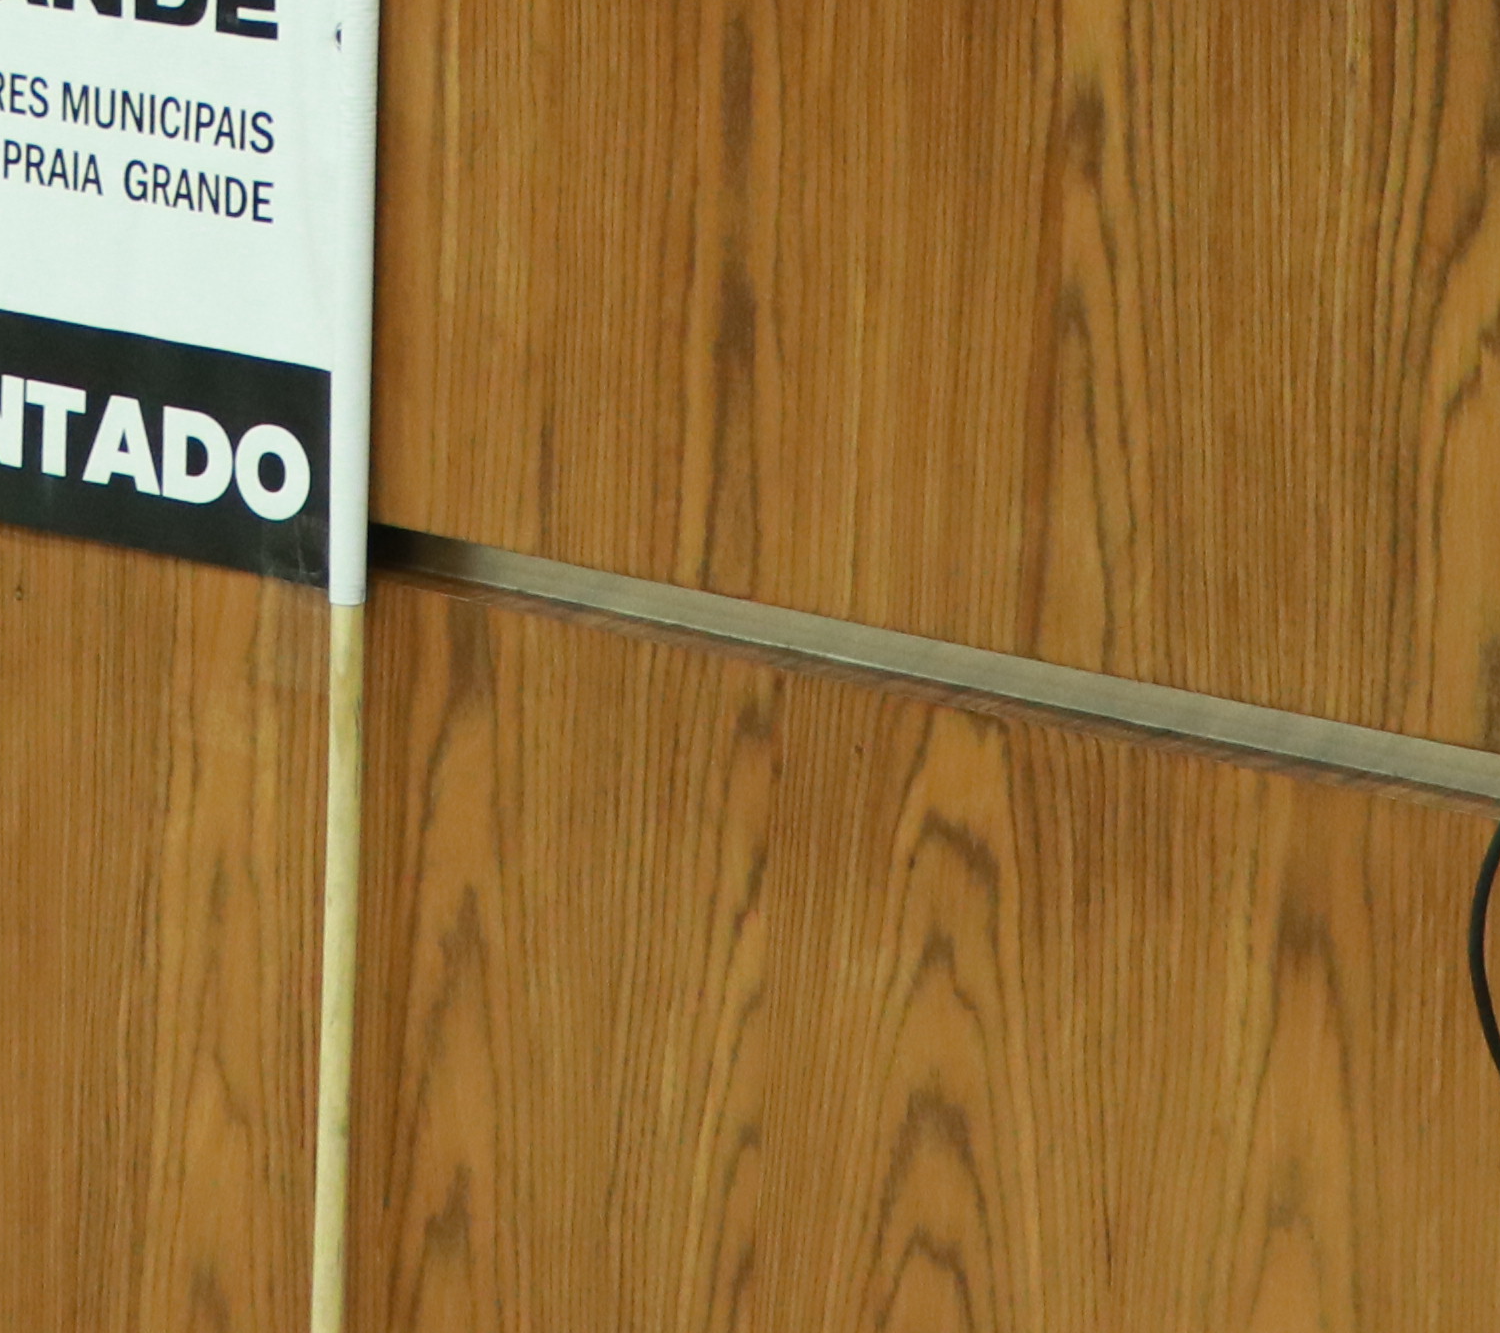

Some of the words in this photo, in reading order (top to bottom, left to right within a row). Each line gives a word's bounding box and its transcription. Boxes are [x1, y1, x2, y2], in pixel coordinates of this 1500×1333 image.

[61, 81, 275, 154] MUNICIPAIS
[2, 139, 104, 196] PRAIA
[123, 159, 275, 224] GRANDE
